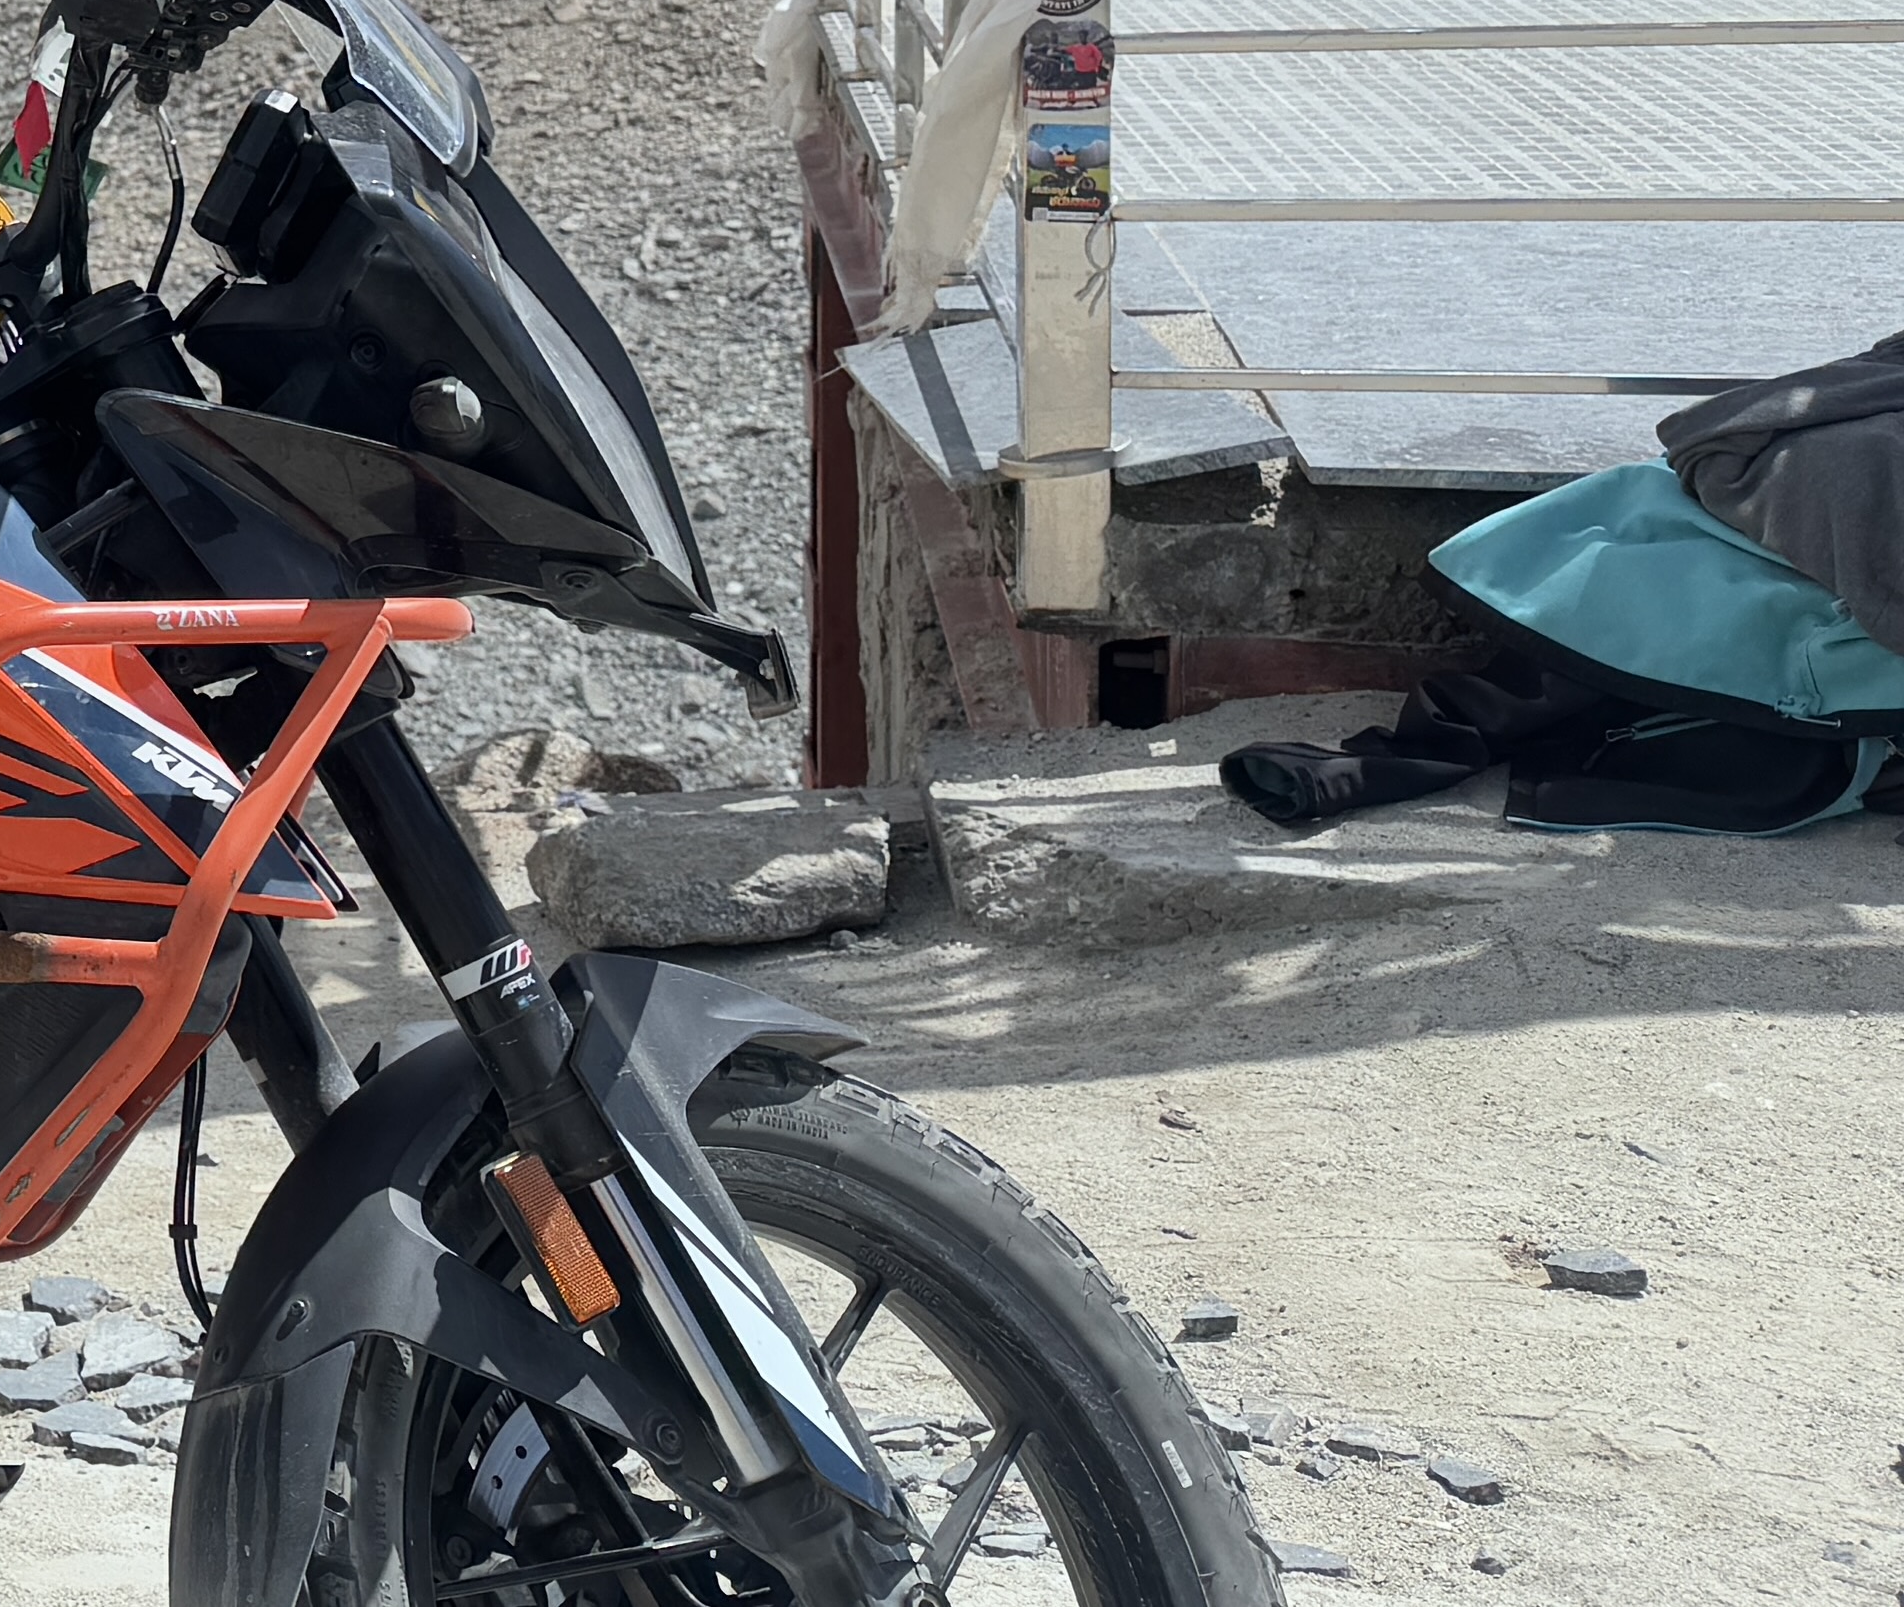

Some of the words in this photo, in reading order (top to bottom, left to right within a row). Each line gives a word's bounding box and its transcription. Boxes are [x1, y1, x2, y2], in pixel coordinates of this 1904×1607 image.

[178, 609, 241, 628] ZANA
[132, 741, 235, 813] KTM
[500, 973, 537, 999] APEX
